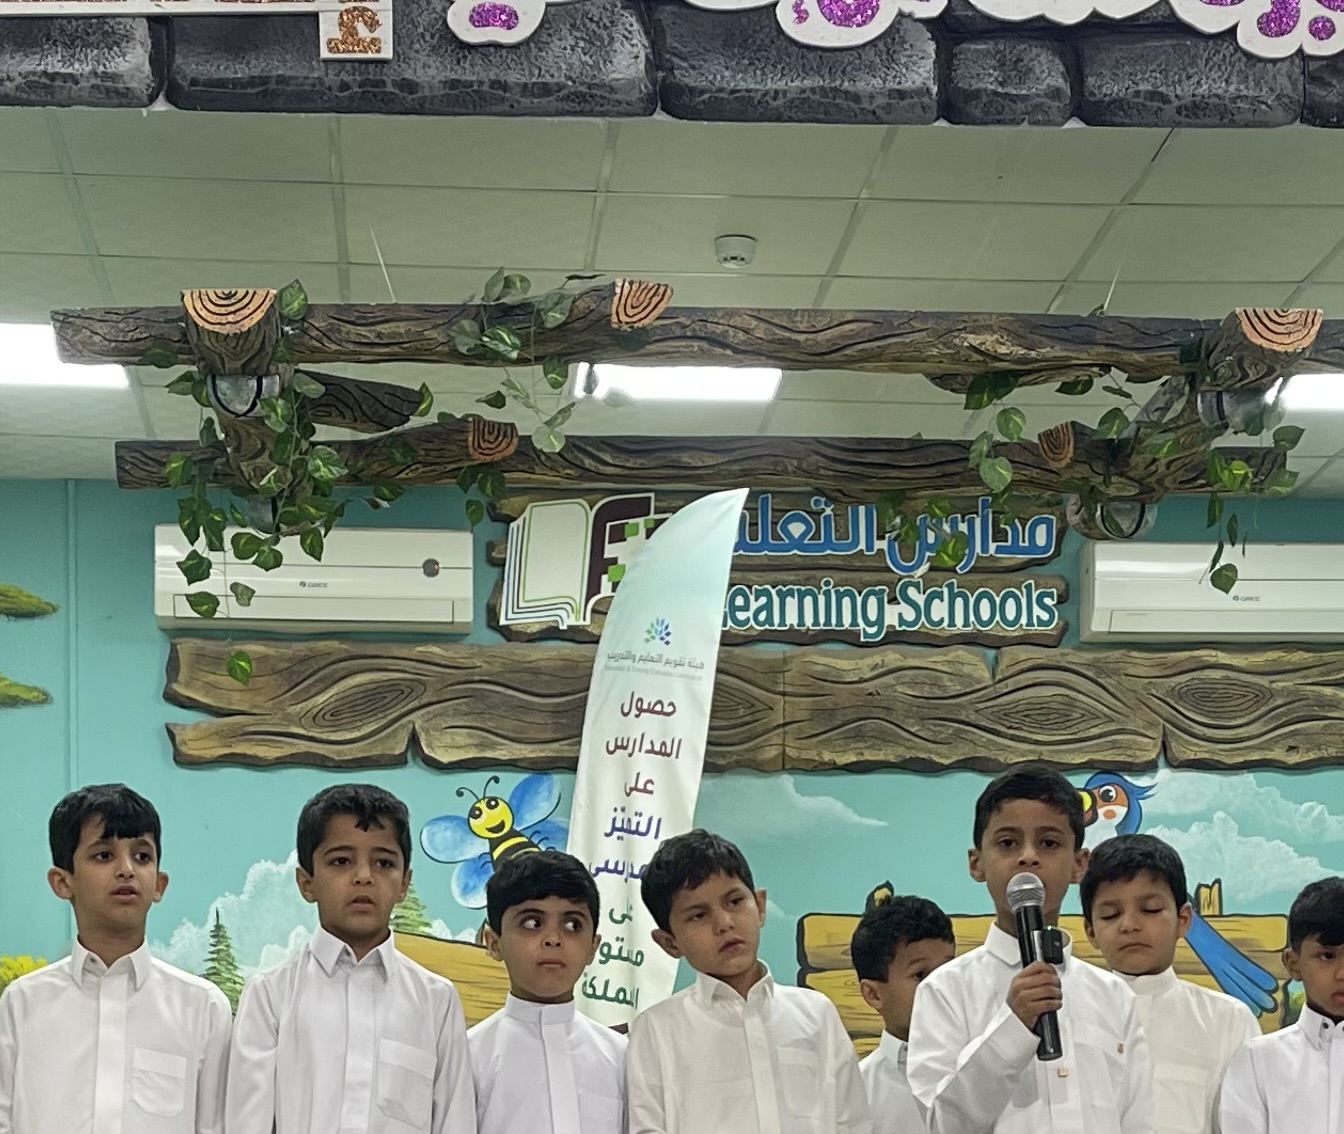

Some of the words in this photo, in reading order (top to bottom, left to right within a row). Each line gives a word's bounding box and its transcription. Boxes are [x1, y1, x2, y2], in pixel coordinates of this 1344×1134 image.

[721, 578, 887, 642] earning
[895, 578, 1058, 630] Schools
[620, 691, 677, 718] حصول
[605, 732, 682, 760] المدارس
[624, 771, 655, 797] على
